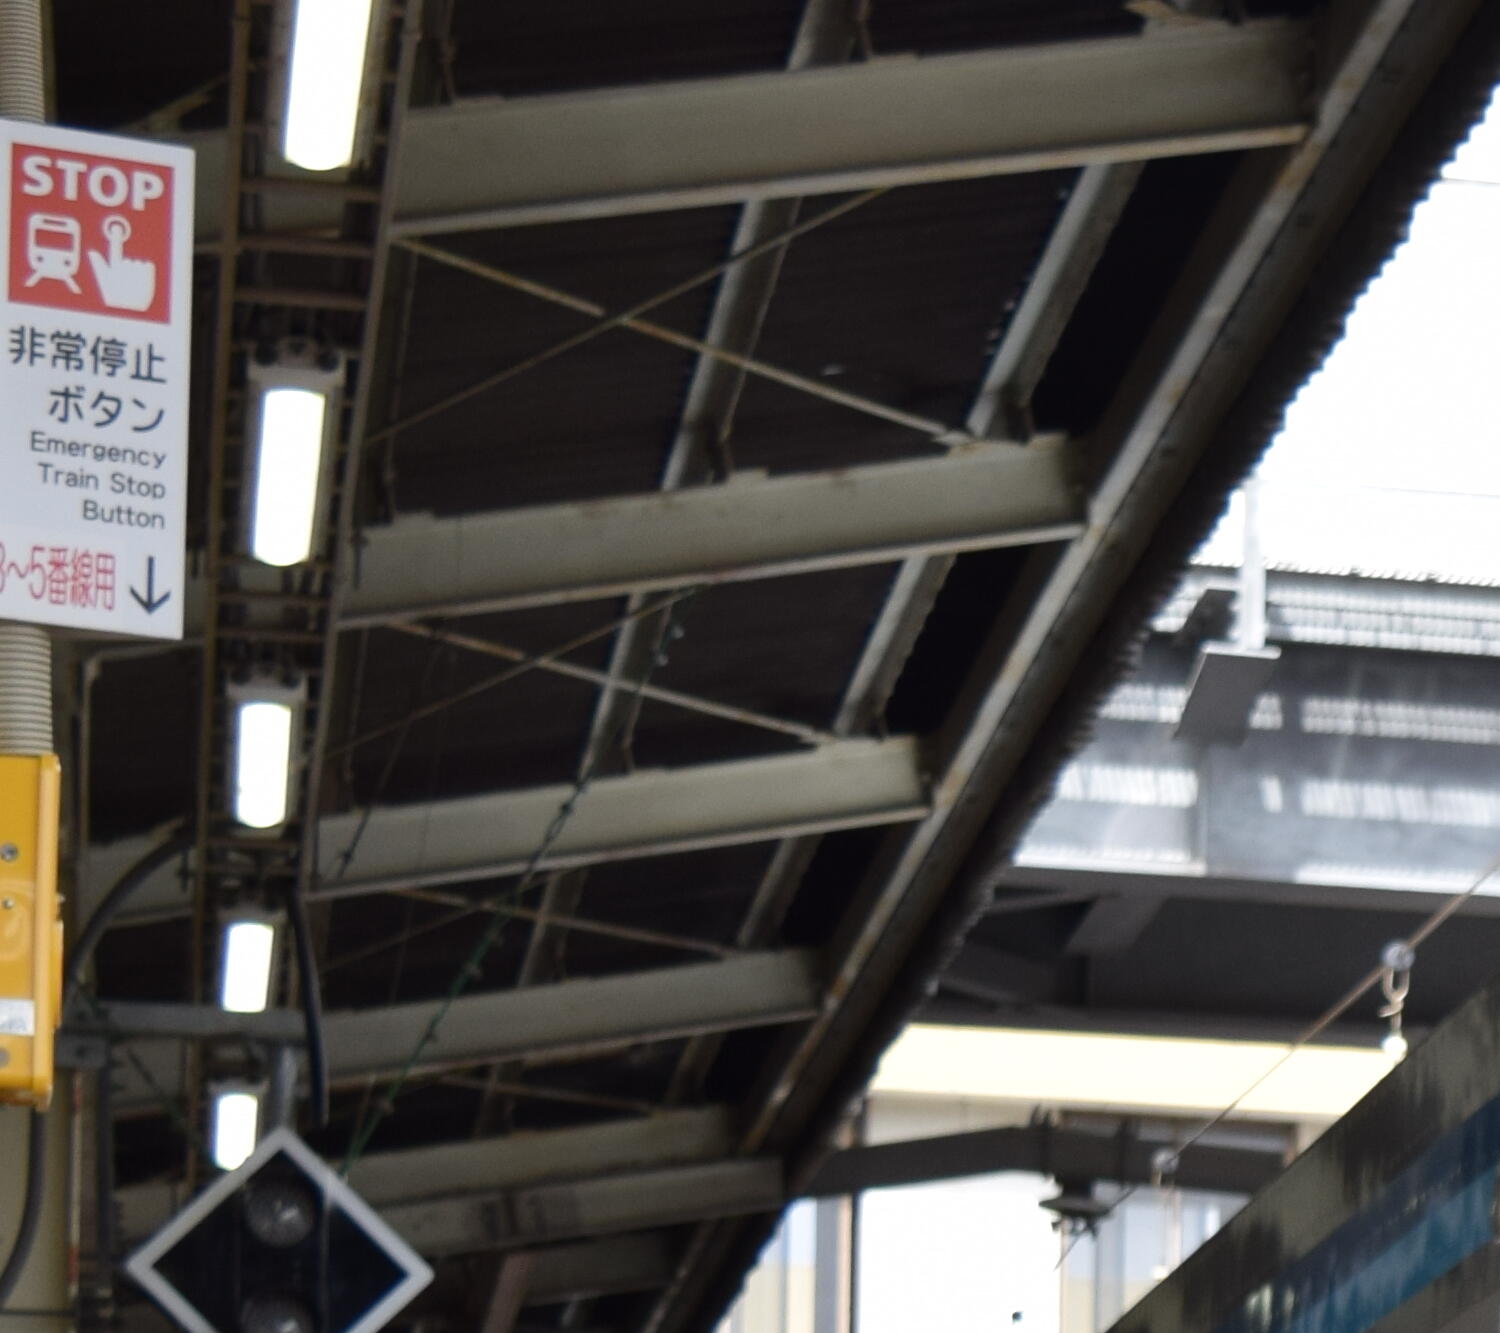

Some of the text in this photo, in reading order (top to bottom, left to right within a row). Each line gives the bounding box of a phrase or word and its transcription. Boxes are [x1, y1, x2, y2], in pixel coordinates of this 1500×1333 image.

[22, 154, 165, 212] STOP
[9, 324, 167, 384] 非常停止
[48, 385, 165, 432] ボタン
[30, 429, 167, 469] Emergency
[37, 462, 166, 499] Train Stop
[82, 499, 165, 529] Button
